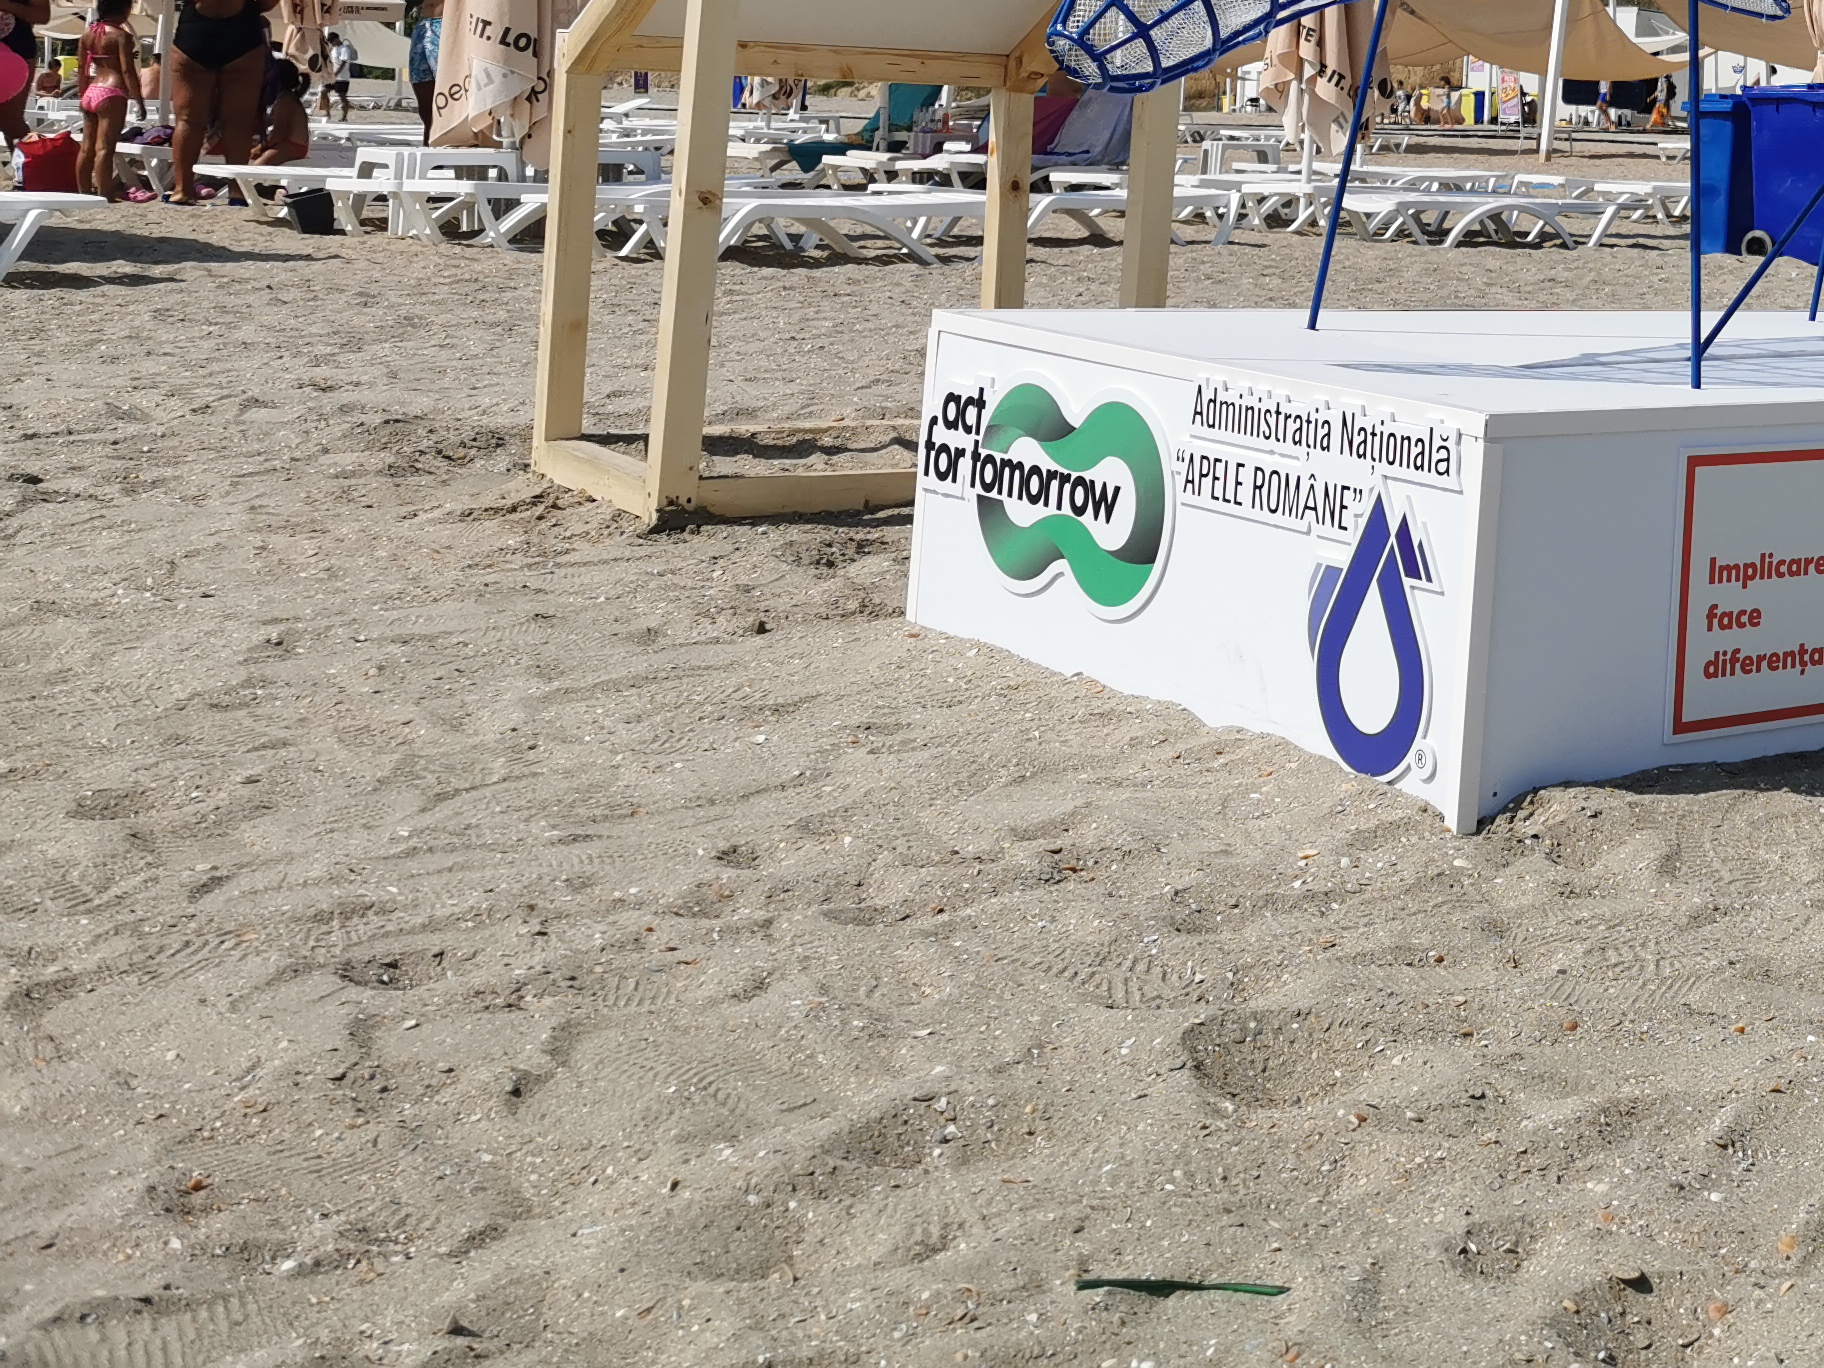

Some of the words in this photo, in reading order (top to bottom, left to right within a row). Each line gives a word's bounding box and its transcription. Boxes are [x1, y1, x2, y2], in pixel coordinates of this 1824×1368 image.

[942, 386, 986, 437] act
[1191, 384, 1332, 463] Administrația
[1340, 410, 1452, 478] Națională
[923, 415, 966, 484] for
[969, 438, 1121, 525] tomorrow
[1706, 604, 1762, 633] face
